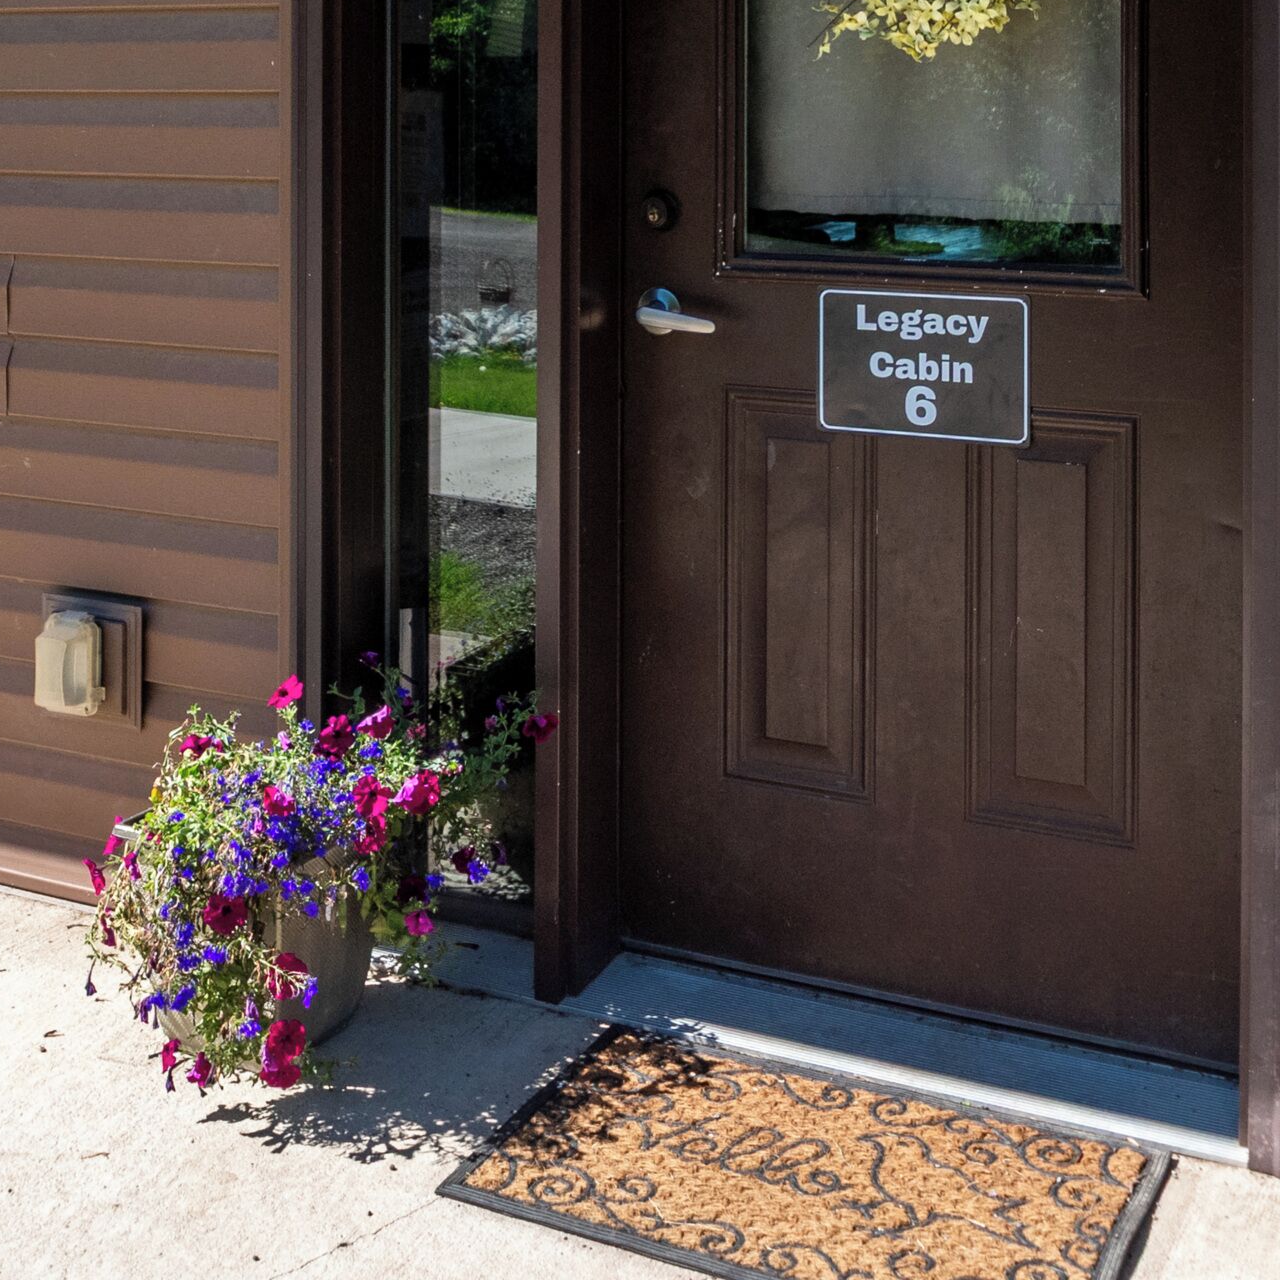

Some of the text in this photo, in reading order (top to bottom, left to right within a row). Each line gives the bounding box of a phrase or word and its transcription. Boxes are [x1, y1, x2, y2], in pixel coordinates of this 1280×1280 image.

[857, 303, 989, 344] Legacy
[869, 351, 974, 384] Cabin
[904, 385, 938, 427] 6
